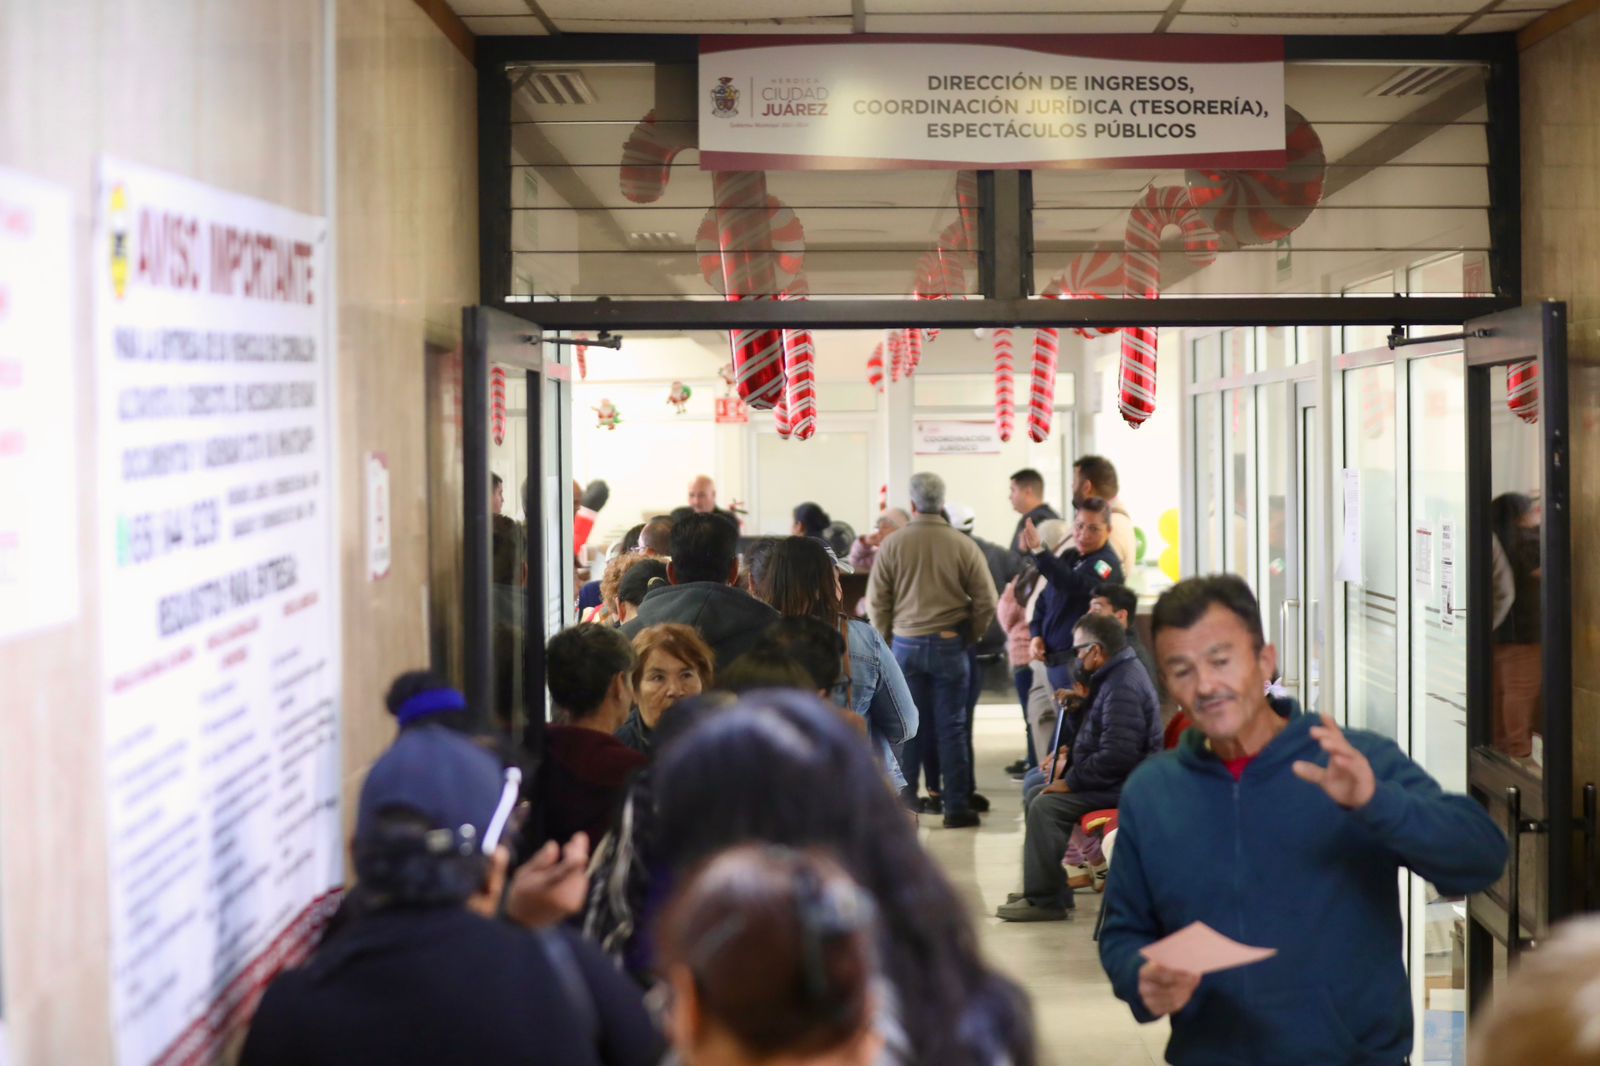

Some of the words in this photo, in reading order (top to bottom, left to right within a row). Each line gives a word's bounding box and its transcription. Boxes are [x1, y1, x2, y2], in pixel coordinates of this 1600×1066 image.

[928, 71, 1042, 91] DIRECCIÓN
[1050, 76, 1077, 91] DE
[1084, 76, 1195, 94] INGRESOS,
[761, 86, 830, 101] CIUDAD
[761, 100, 829, 116] JUÁREZ
[853, 95, 1019, 115] COORDINACIÓN
[1025, 96, 1123, 115] JURÍDICA
[1130, 96, 1269, 118] (TESORERÍA),
[927, 120, 1087, 139] ESPECTÁCULOS
[1094, 120, 1197, 139] PÚBLICOS
